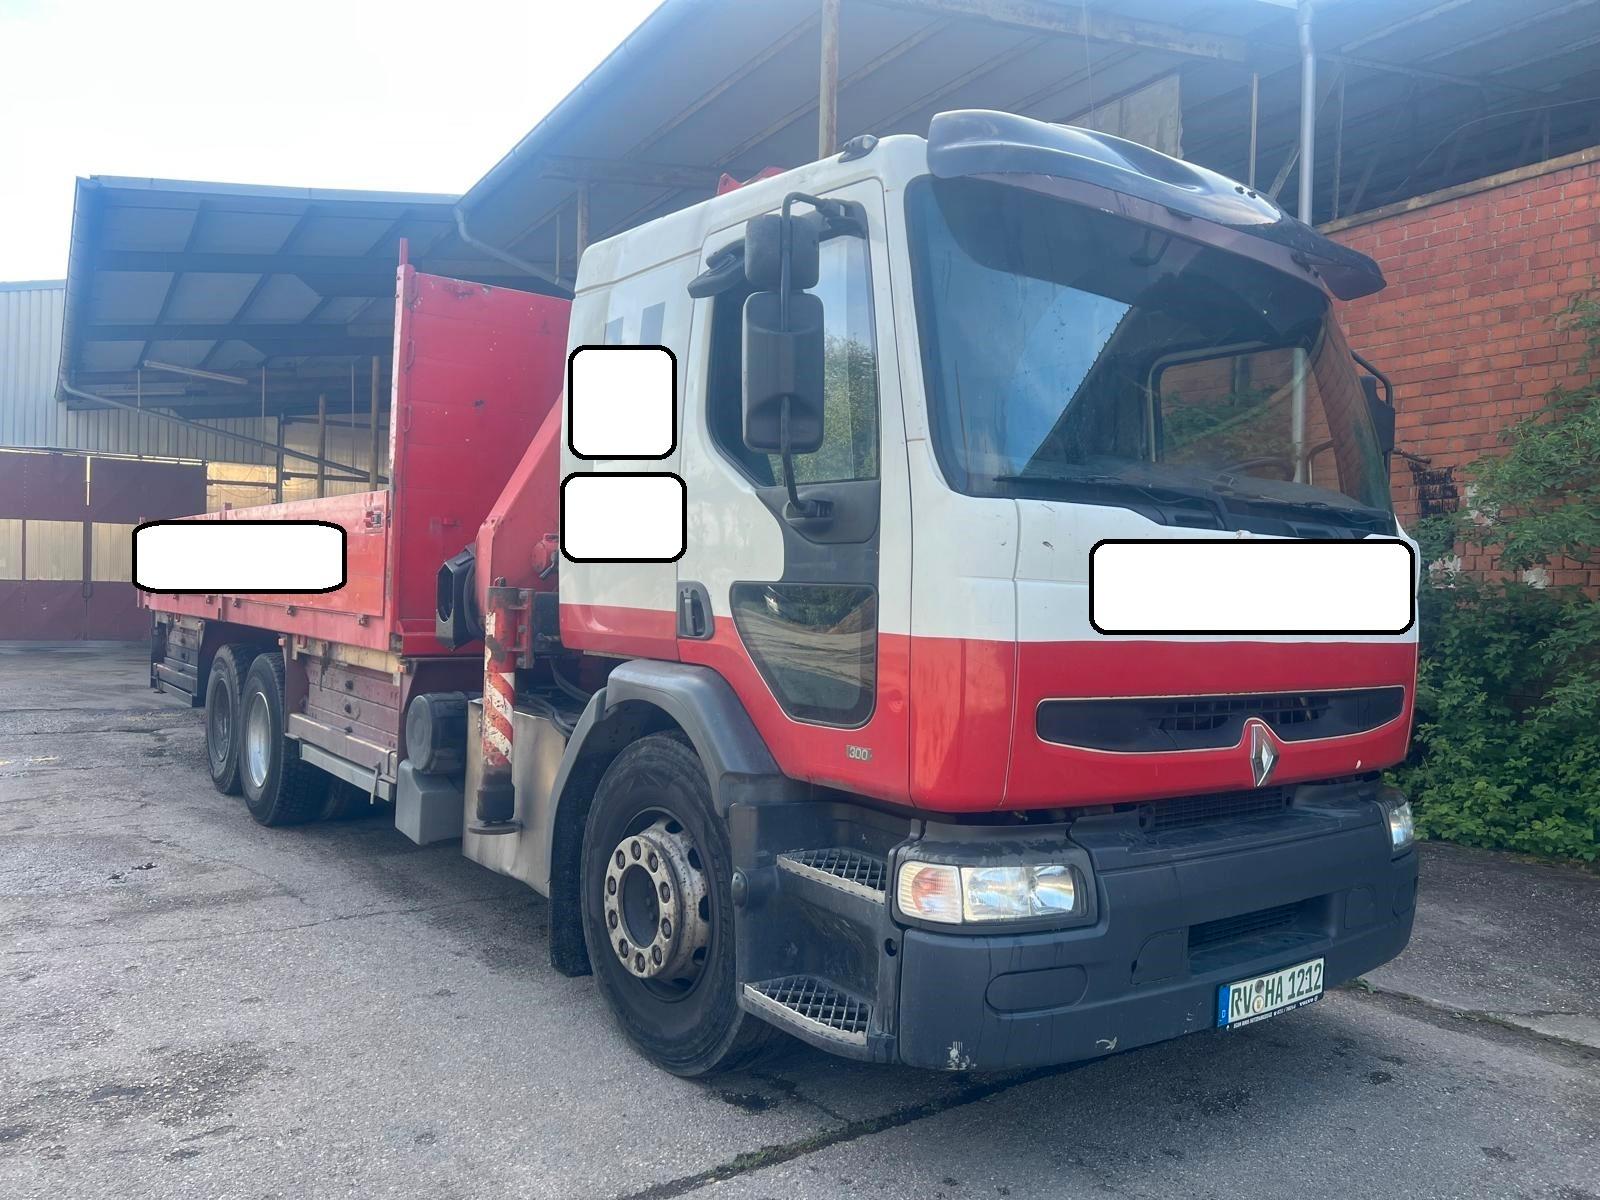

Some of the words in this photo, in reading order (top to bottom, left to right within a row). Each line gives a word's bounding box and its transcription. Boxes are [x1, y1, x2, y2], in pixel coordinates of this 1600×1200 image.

[849, 746, 868, 761] 300
[1231, 984, 1253, 1018] RV
[1264, 975, 1283, 1008] HA
[1287, 962, 1322, 1000] 1212
